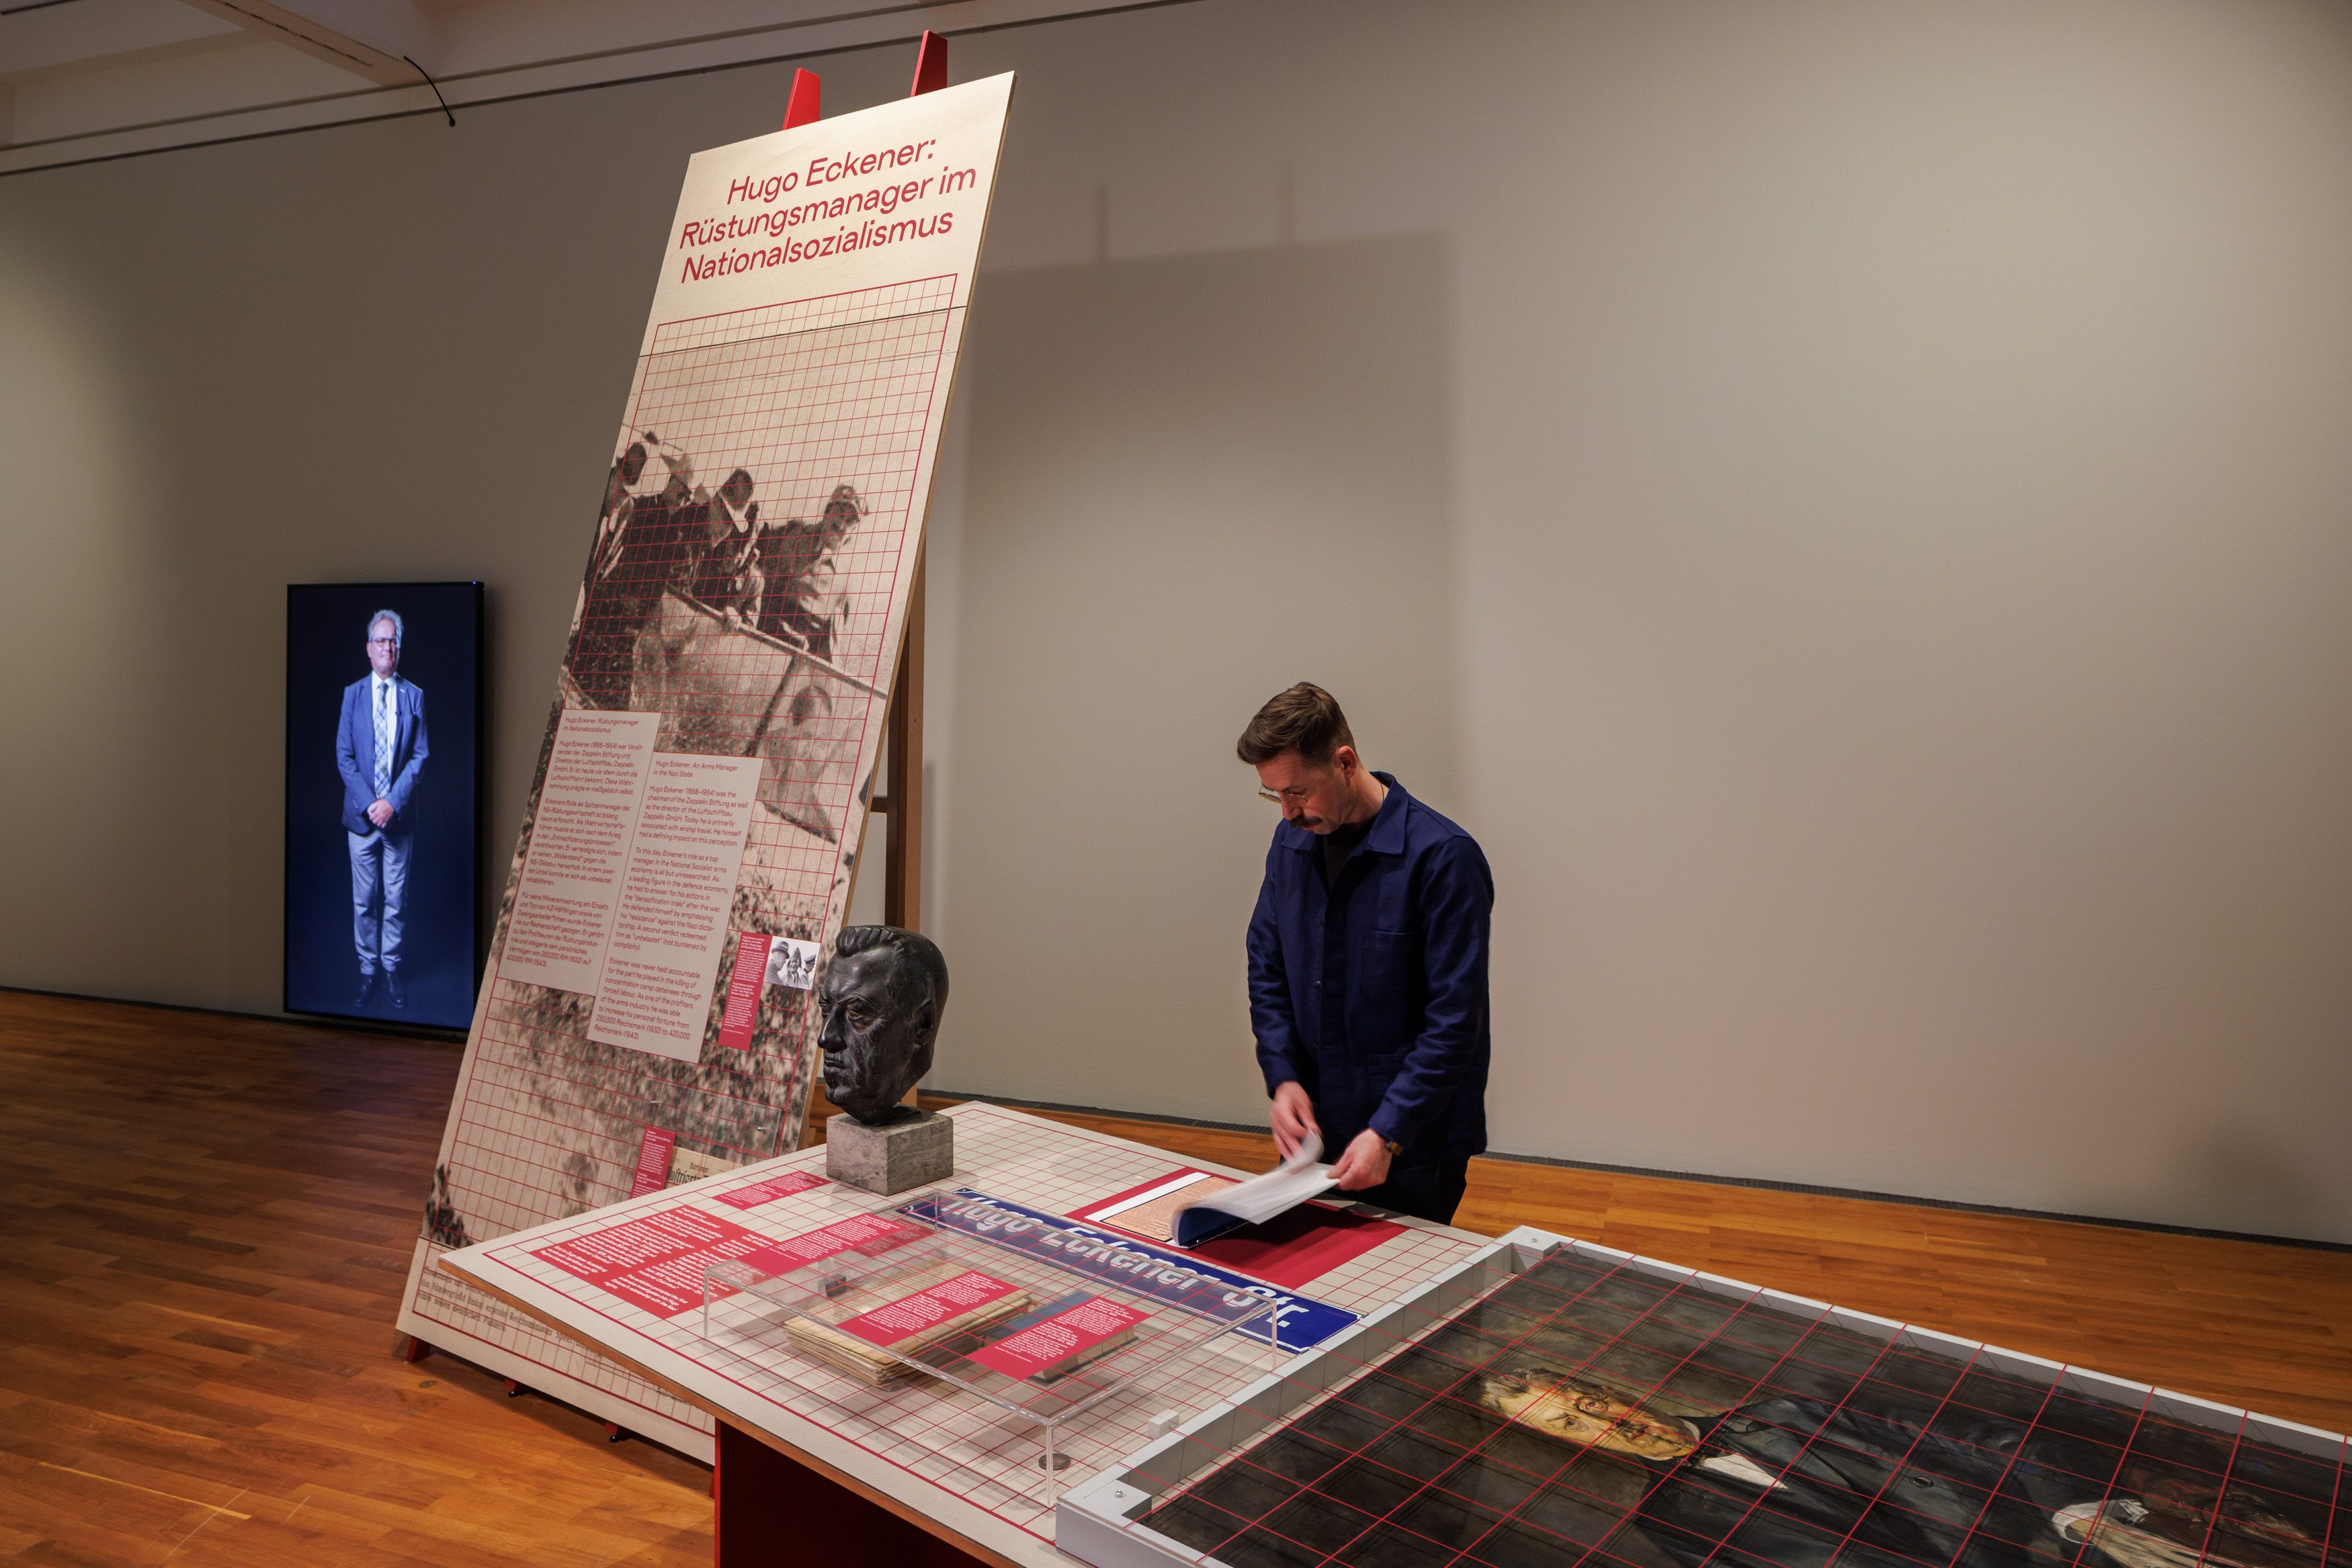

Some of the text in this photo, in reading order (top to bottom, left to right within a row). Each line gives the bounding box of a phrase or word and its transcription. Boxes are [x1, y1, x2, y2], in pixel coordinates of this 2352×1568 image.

[727, 139, 935, 204] Hugo Eckener:
[679, 166, 976, 249] Rüstungsmanager im
[681, 212, 953, 283] Nationalsozialismus
[655, 760, 669, 769] Hugo
[715, 763, 738, 773] Manager
[679, 770, 693, 778] State
[649, 785, 663, 793] Hugo
[663, 785, 684, 793] Eckener
[685, 797, 708, 805] Zeppelin
[708, 799, 730, 808] Stiftung
[697, 808, 732, 817] Luftschiffbau
[643, 812, 665, 820] Zeppelin
[684, 816, 699, 824] Today
[712, 819, 735, 828] primarily
[652, 832, 673, 841] defining
[633, 857, 655, 866] manager
[670, 861, 691, 869] National
[691, 863, 713, 871] Socialist
[709, 855, 719, 863] top
[630, 867, 653, 875] economy
[632, 875, 650, 885] leading
[650, 877, 666, 886] figure
[681, 882, 703, 890] defence
[630, 904, 655, 913] defended
[655, 908, 673, 916] himself
[673, 910, 681, 918] by
[681, 912, 713, 923] emphasising
[610, 957, 630, 966] Eckener
[657, 965, 669, 973] held
[668, 969, 700, 979] accountable
[605, 977, 702, 1001] concentration camp detainees through
